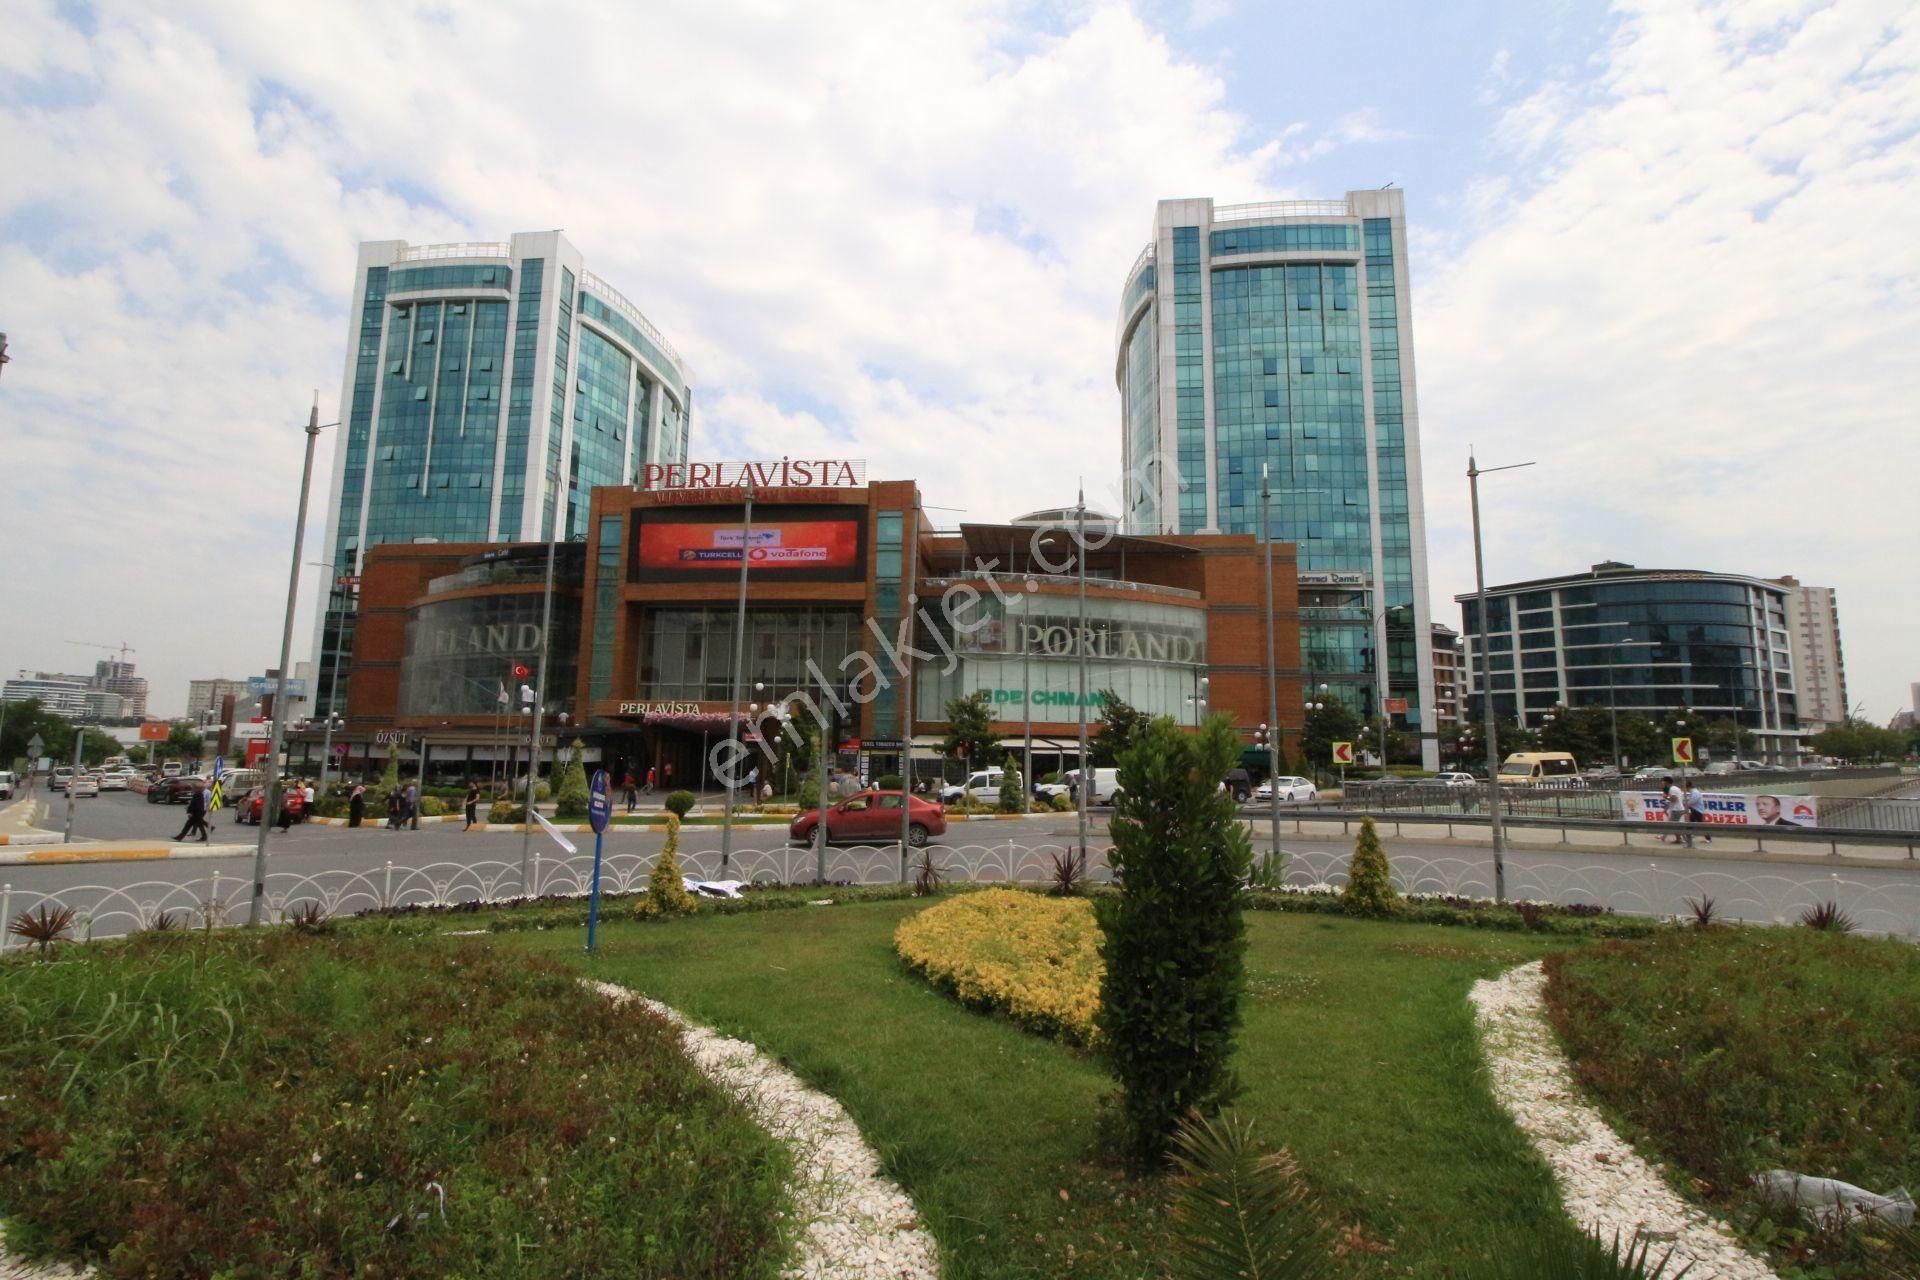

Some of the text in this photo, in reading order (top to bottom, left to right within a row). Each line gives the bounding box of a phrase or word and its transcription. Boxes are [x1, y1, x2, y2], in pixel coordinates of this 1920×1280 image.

[644, 456, 858, 489] PERLAVİSTA
[699, 551, 743, 559] TURKCELL
[770, 549, 826, 559] vodafone
[1330, 573, 1360, 583] Ramiz
[1019, 623, 1194, 664] PORLAND
[619, 700, 701, 715] PERLAVİSTA
